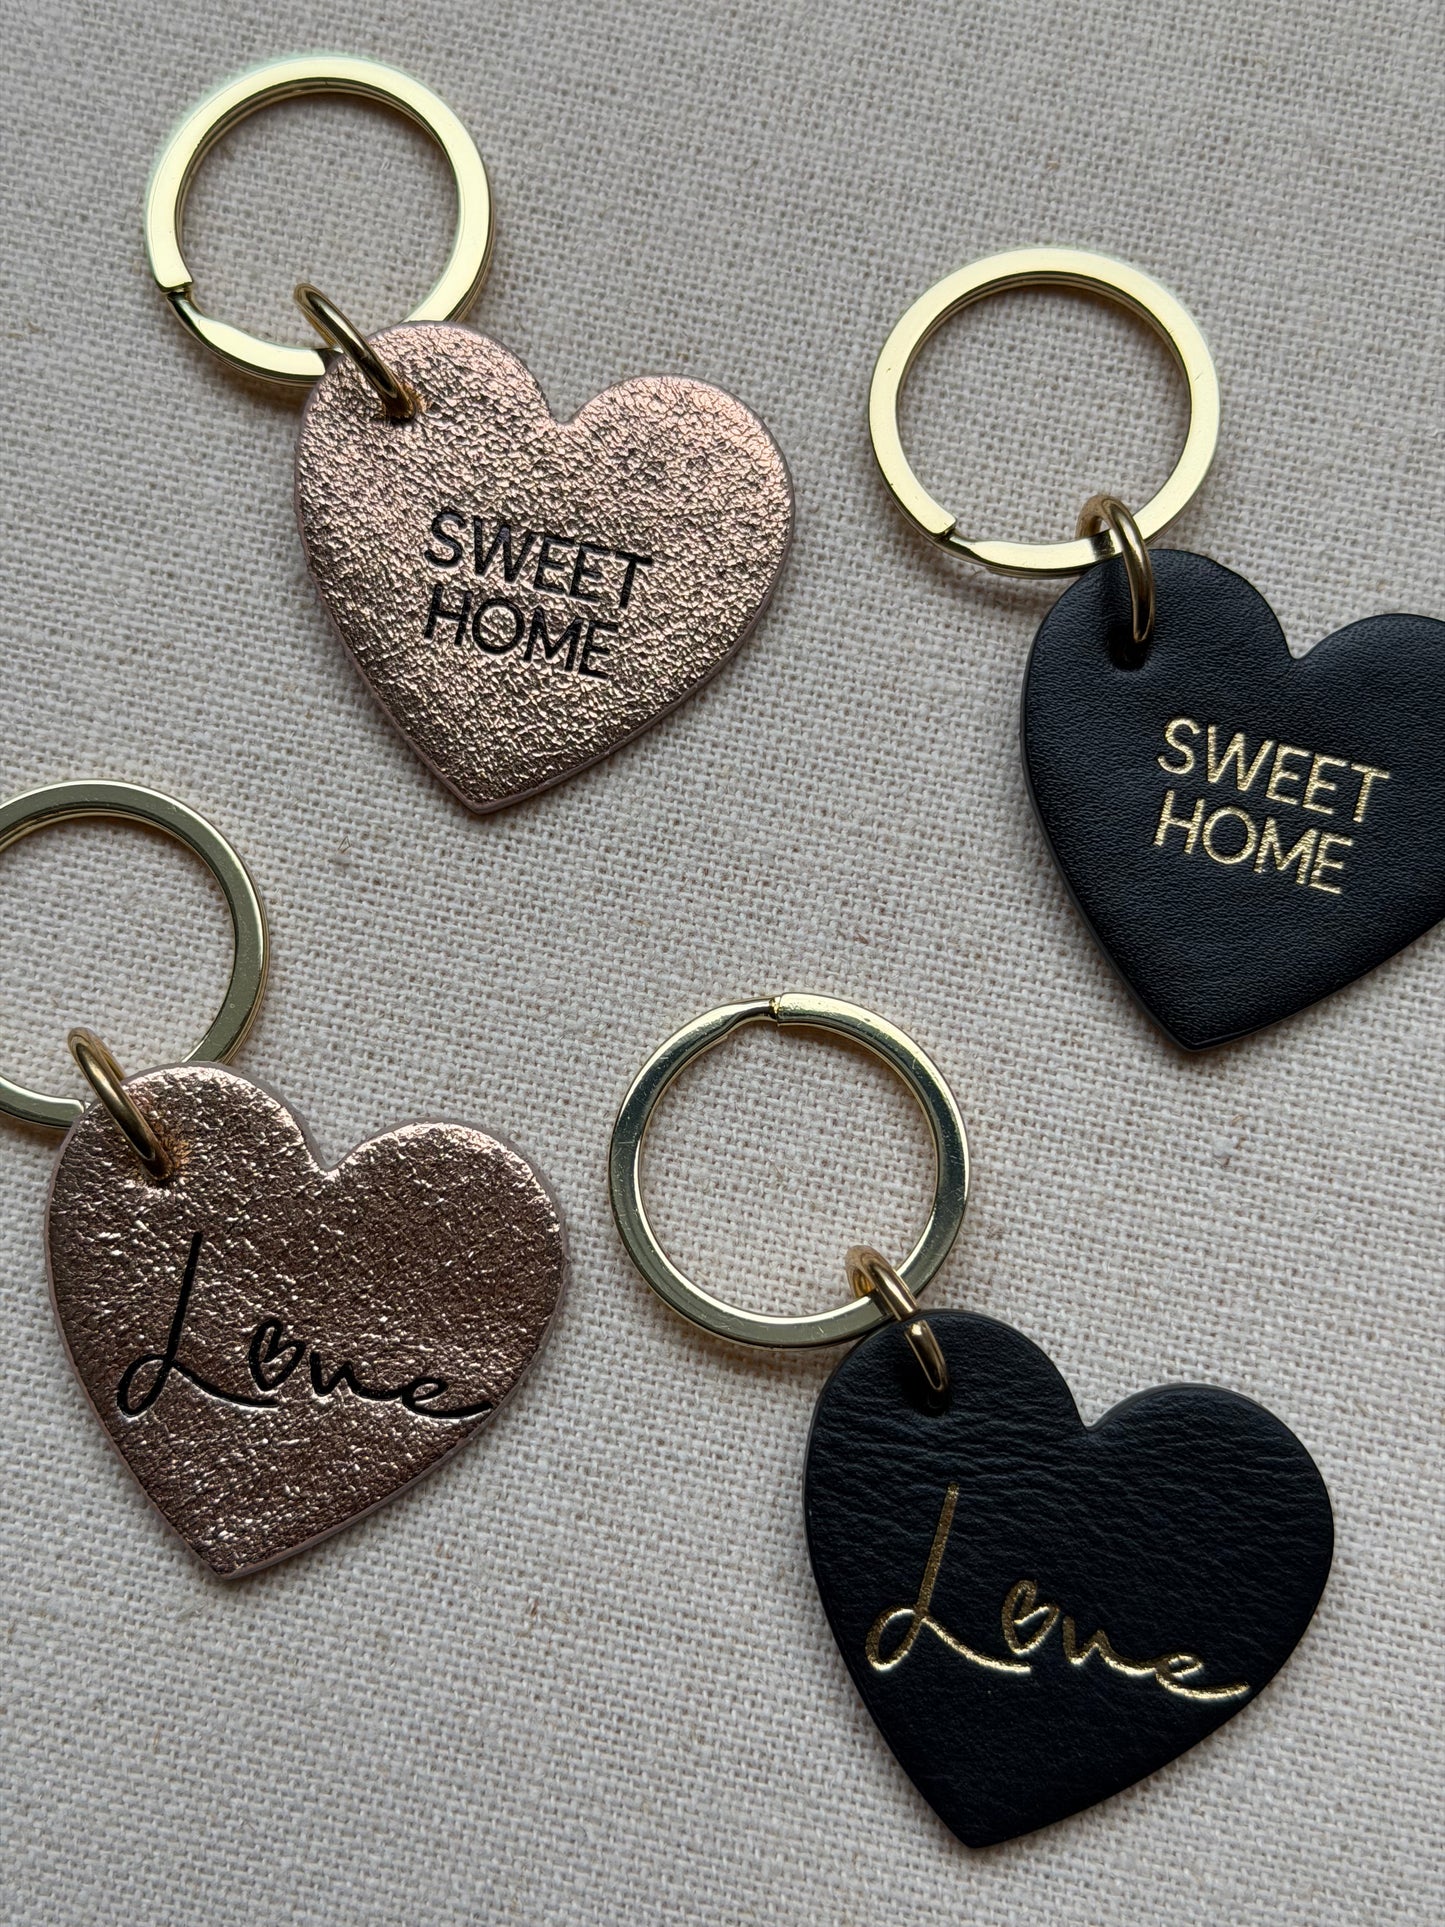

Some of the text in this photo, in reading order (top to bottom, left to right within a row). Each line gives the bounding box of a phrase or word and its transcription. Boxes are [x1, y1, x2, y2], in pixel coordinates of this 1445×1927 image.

[424, 509, 653, 609] SWEET
[424, 584, 618, 680] HOME
[1157, 718, 1391, 823] SWEET
[1153, 790, 1353, 894] HOME
